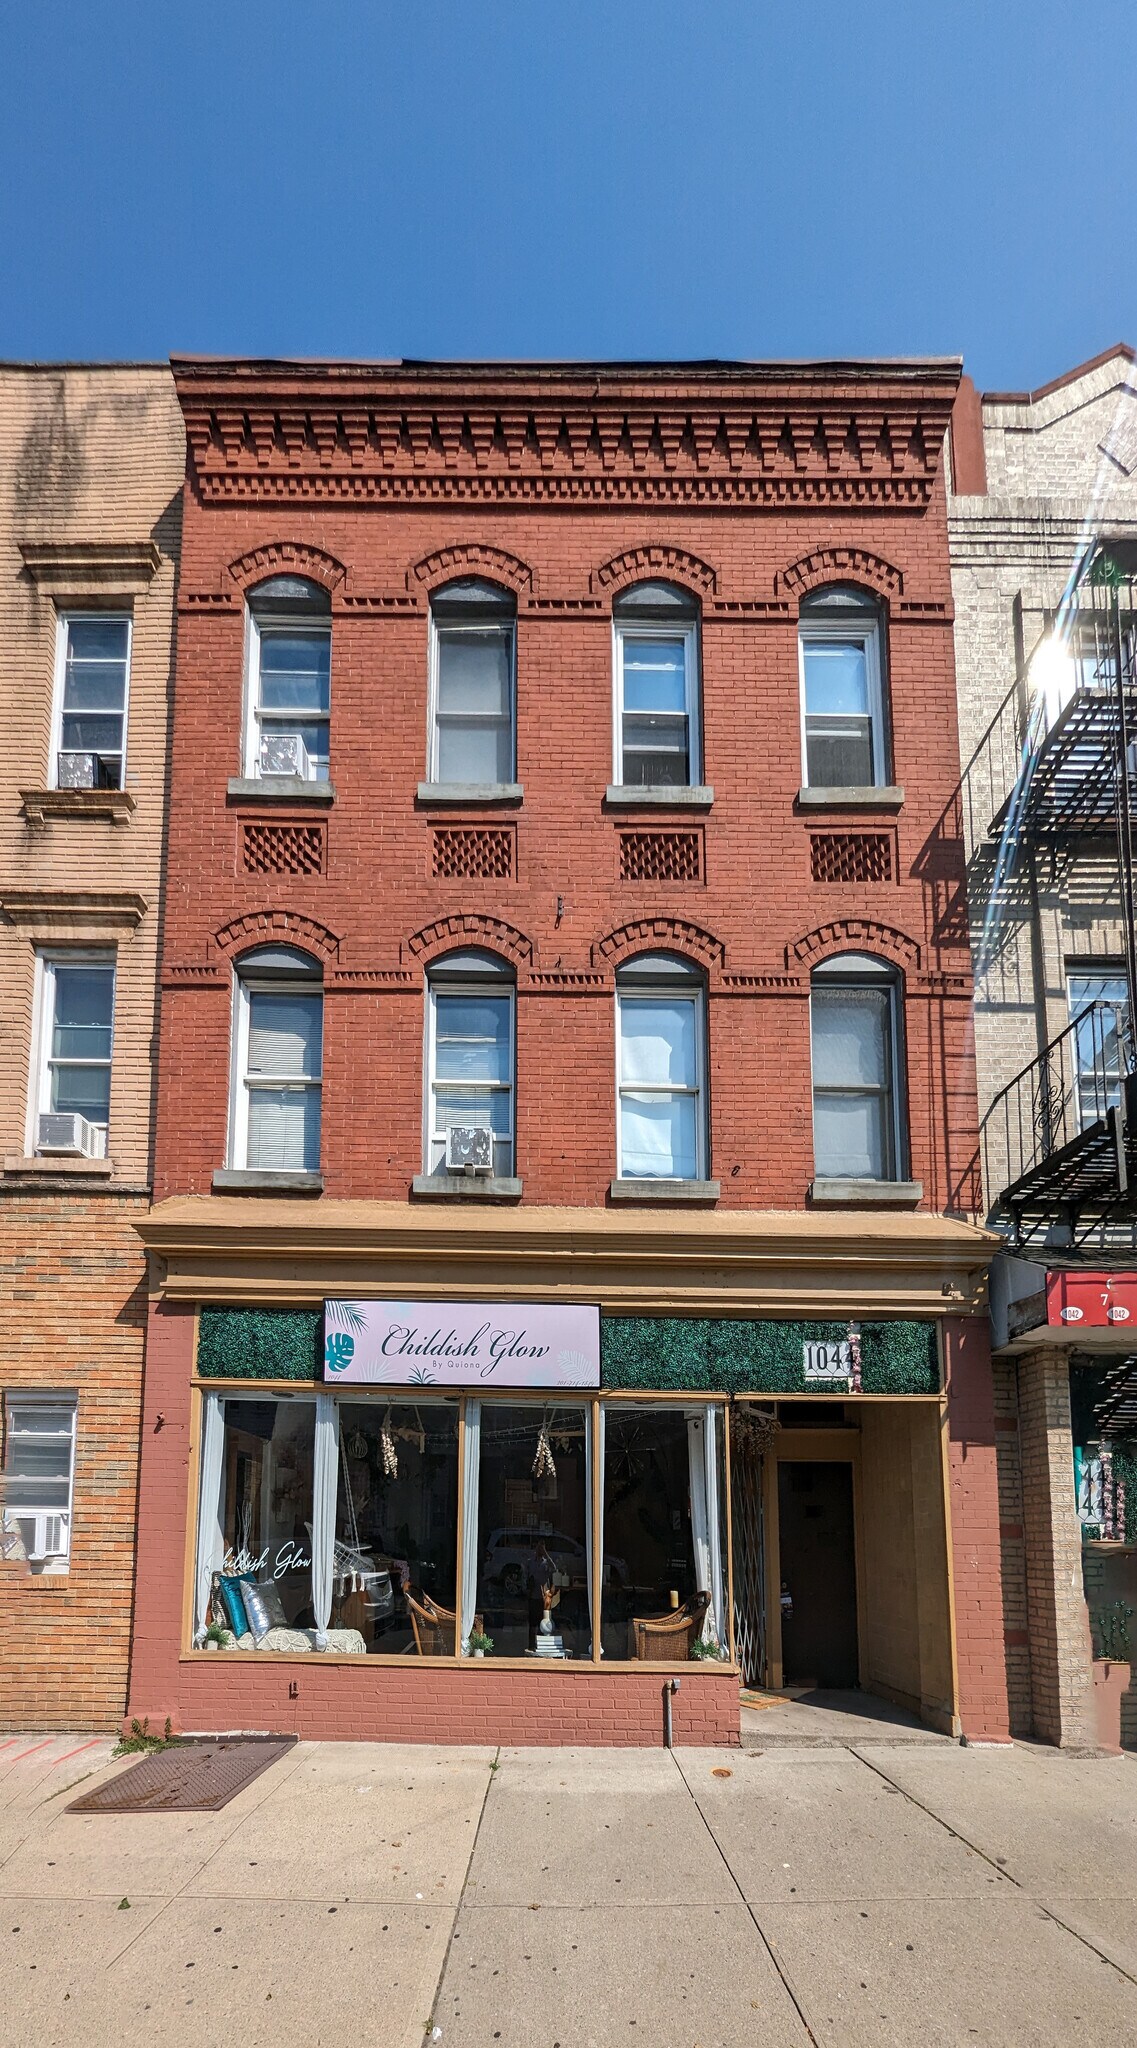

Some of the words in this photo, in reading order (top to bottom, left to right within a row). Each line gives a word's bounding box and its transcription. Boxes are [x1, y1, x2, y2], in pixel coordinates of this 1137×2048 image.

[1064, 1309, 1080, 1319] 1042
[1110, 1309, 1126, 1319] 1042
[381, 1322, 491, 1356] Childish
[480, 1330, 550, 1378] Glow
[807, 1344, 854, 1370] 1044
[432, 1359, 443, 1370] By
[214, 1546, 270, 1571] hildish
[273, 1541, 312, 1579] Glow
